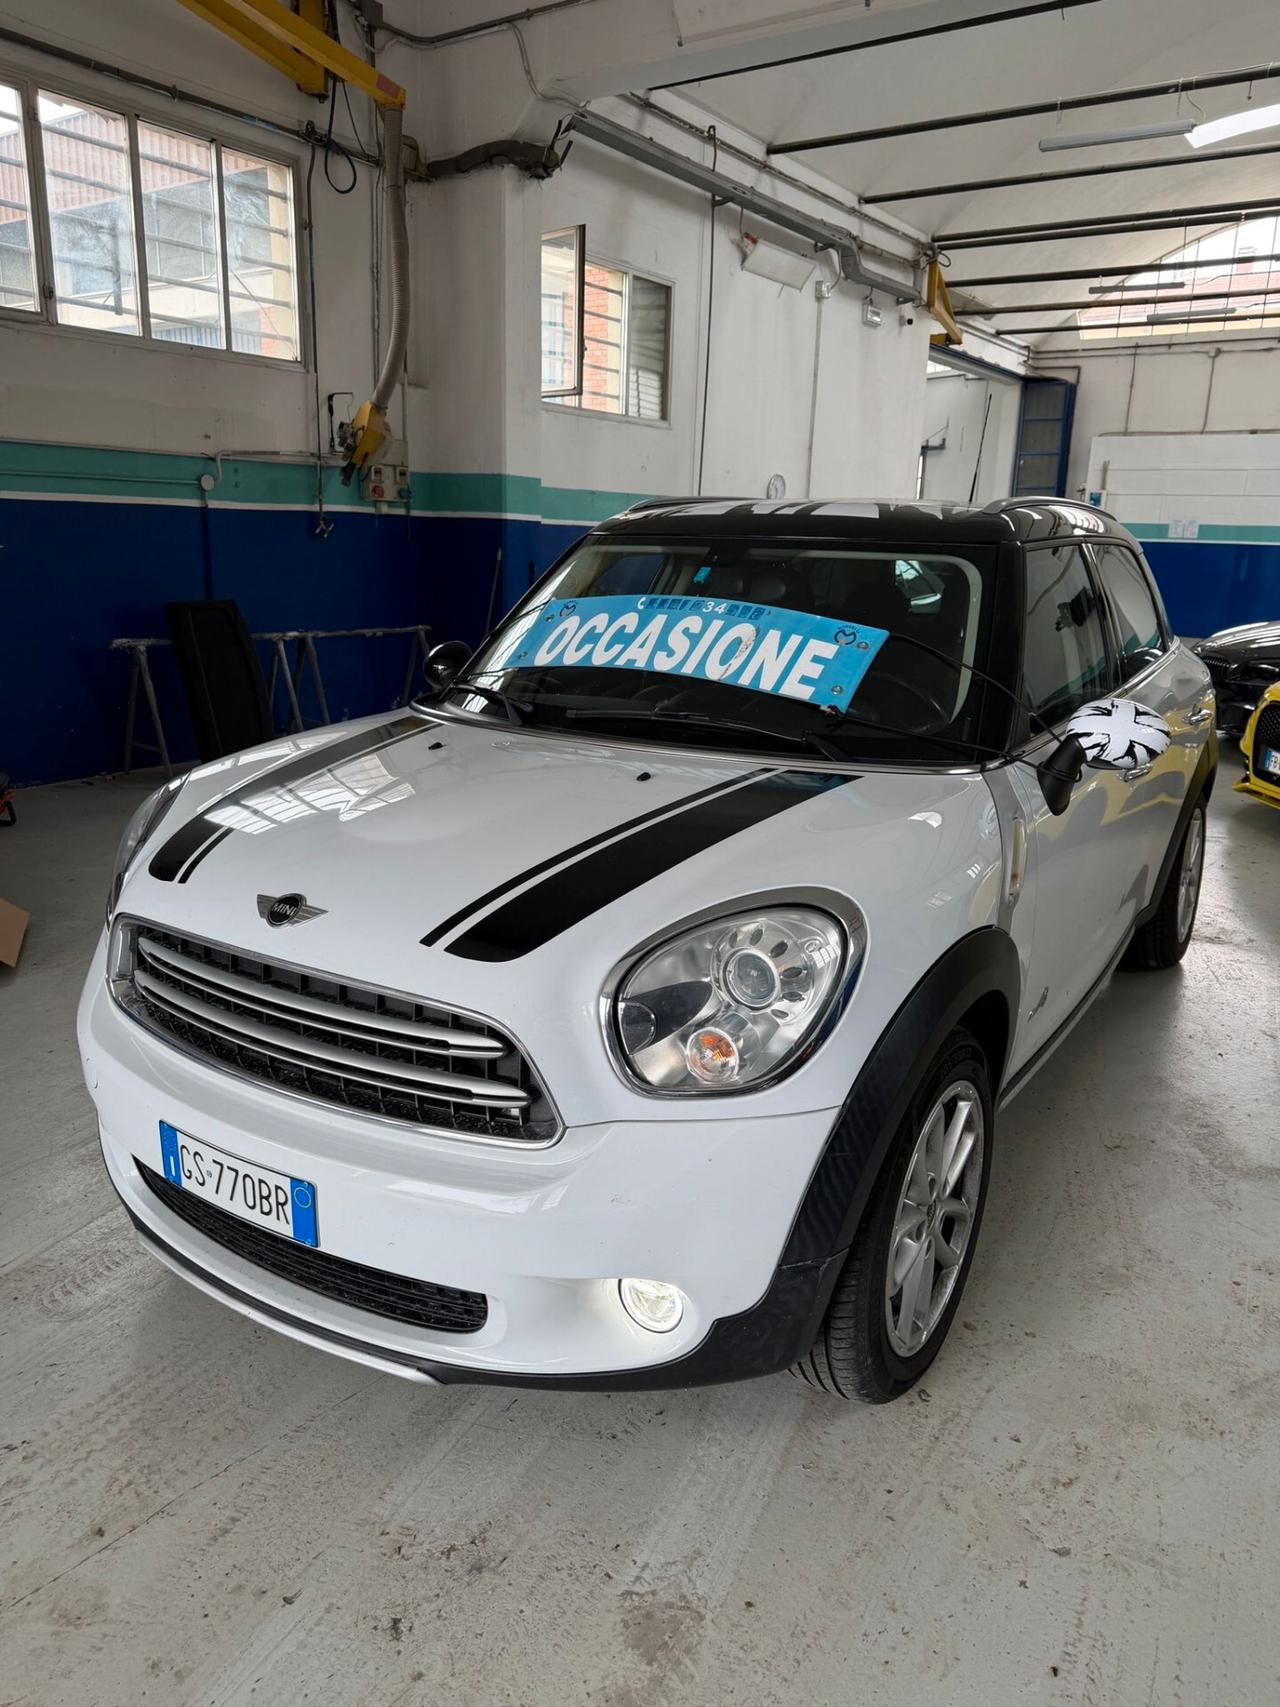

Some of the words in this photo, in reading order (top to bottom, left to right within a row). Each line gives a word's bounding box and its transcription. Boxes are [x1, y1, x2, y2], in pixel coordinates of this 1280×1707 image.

[703, 601, 727, 614] 34
[534, 613, 839, 700] OCCASIONE
[272, 902, 297, 916] MINI
